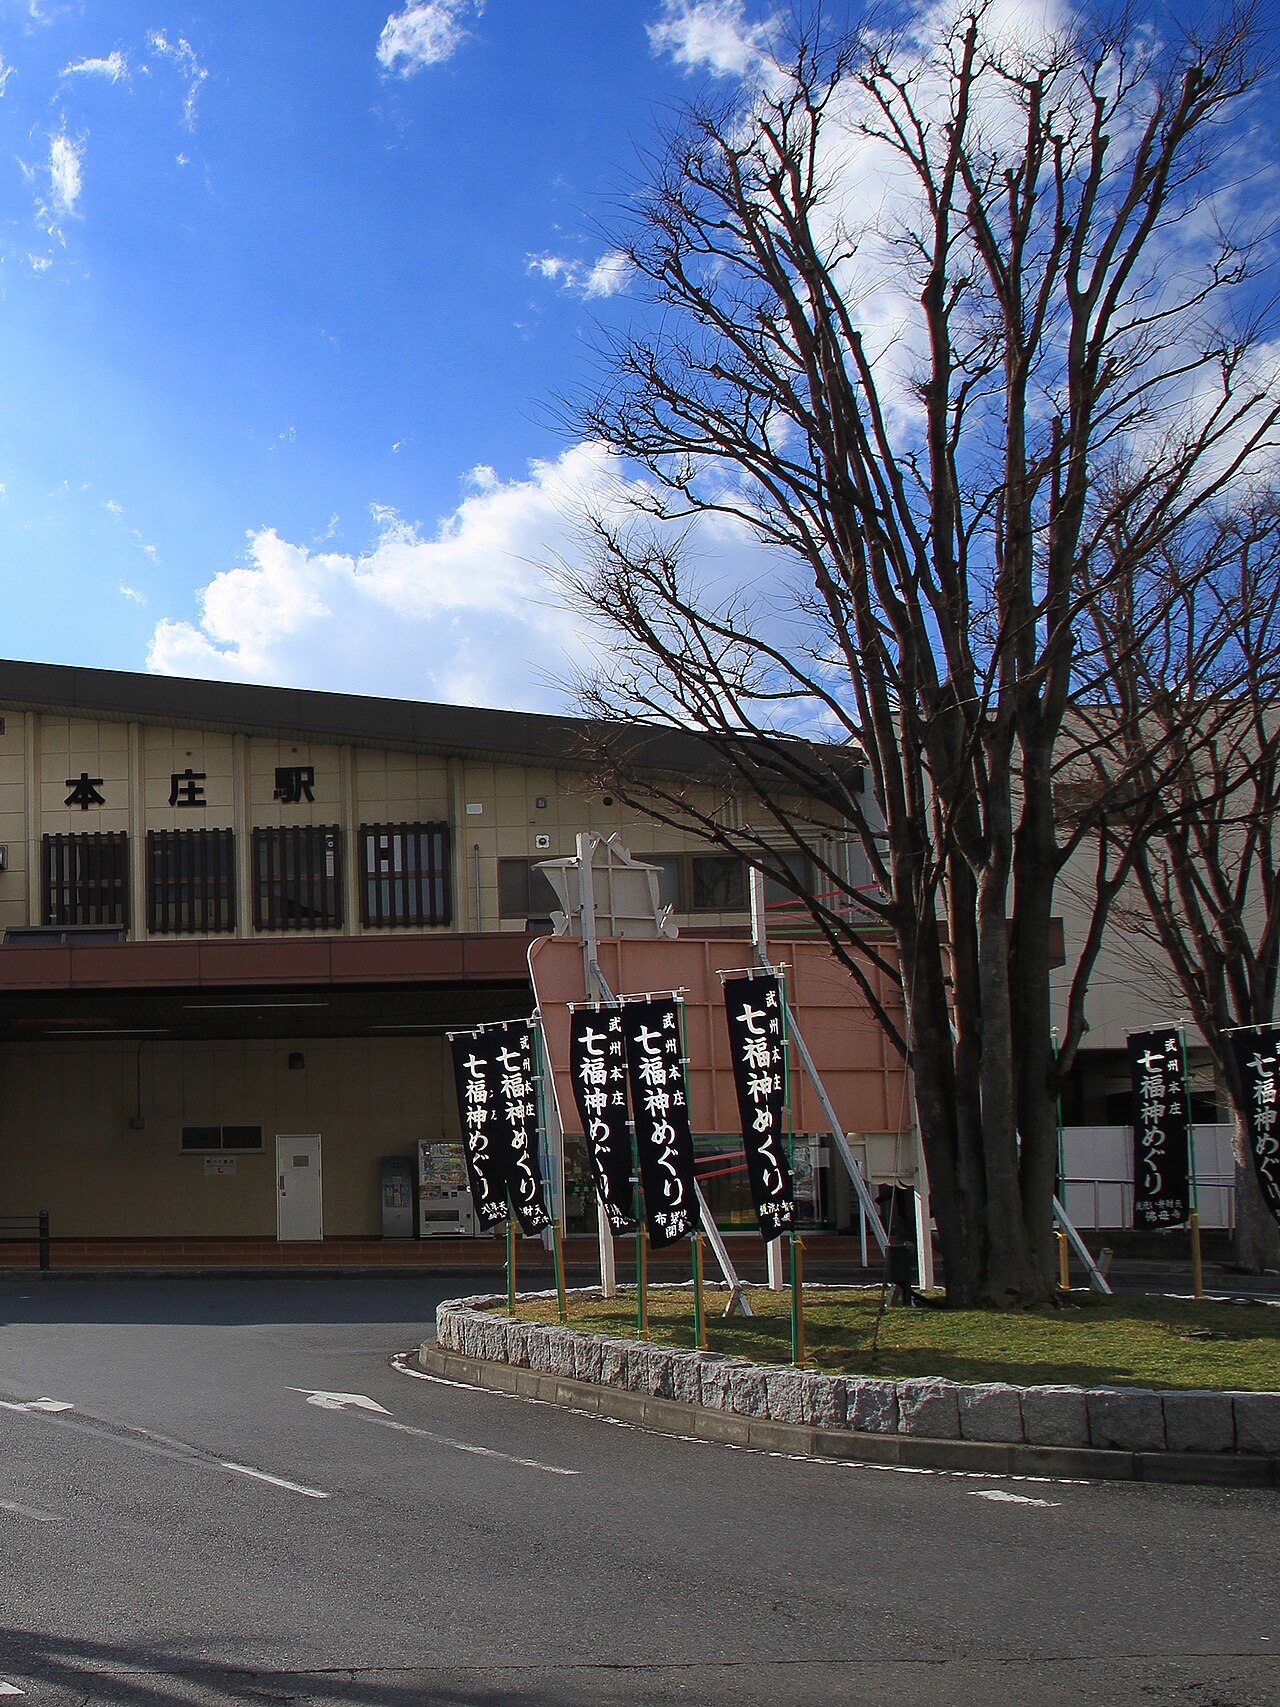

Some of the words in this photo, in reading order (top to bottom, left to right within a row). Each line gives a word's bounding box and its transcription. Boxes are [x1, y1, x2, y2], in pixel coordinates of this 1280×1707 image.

[63, 766, 316, 810] 本庄駅
[520, 1035, 536, 1117] 武州本庄
[608, 1016, 625, 1106] 武州本庄
[662, 1012, 686, 1106] 武州本庄
[1164, 1038, 1183, 1115] 武州本庄
[462, 1053, 490, 1200] 七福神めぐり
[495, 1046, 536, 1202] 七福神めぐり
[633, 1025, 684, 1206] 七福神めぐり
[1136, 1049, 1166, 1195] 七福神めぐり
